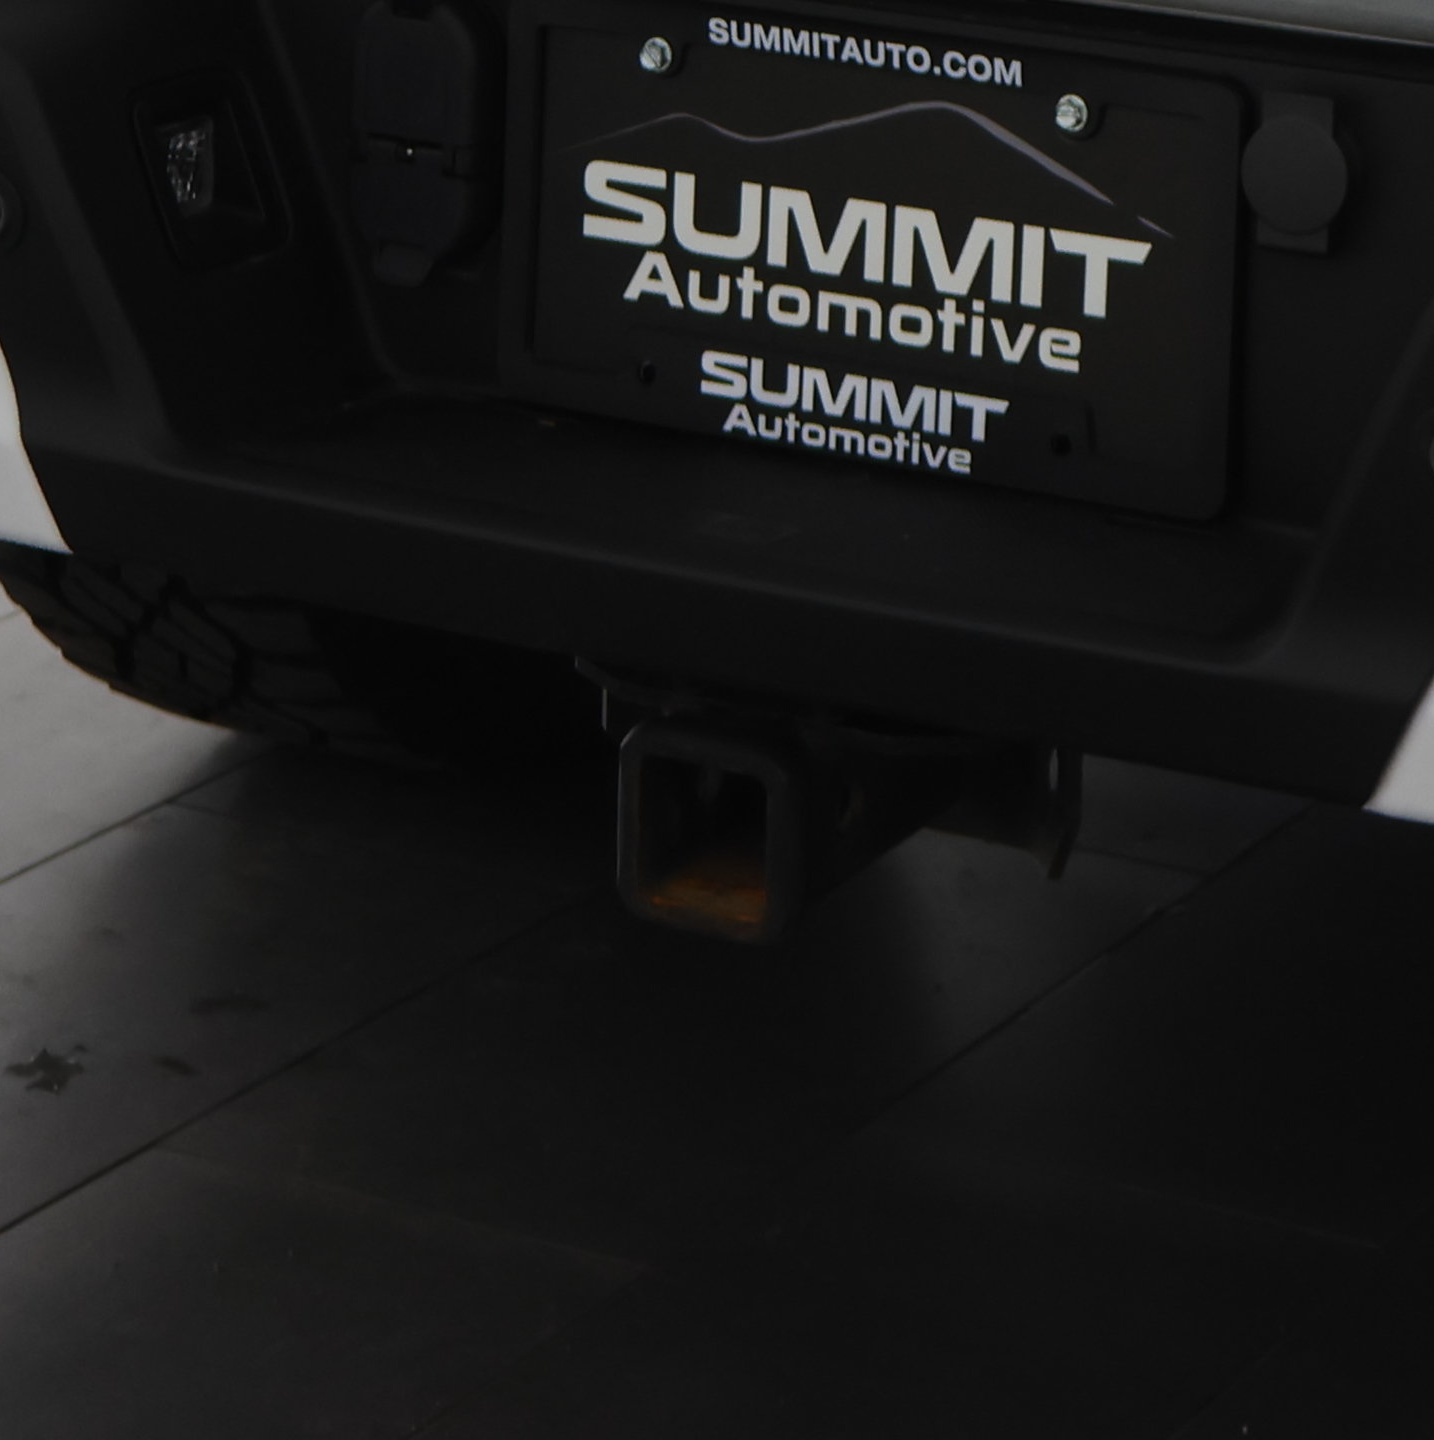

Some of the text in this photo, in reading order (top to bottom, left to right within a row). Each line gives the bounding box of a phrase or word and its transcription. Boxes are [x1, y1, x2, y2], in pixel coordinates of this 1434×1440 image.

[708, 17, 1023, 87] SUMMITAUTO.COM
[582, 160, 1152, 318] SUMMIT
[623, 250, 1082, 373] Automotive
[700, 350, 1009, 442] SUMMIT
[723, 403, 973, 473] Automotive
